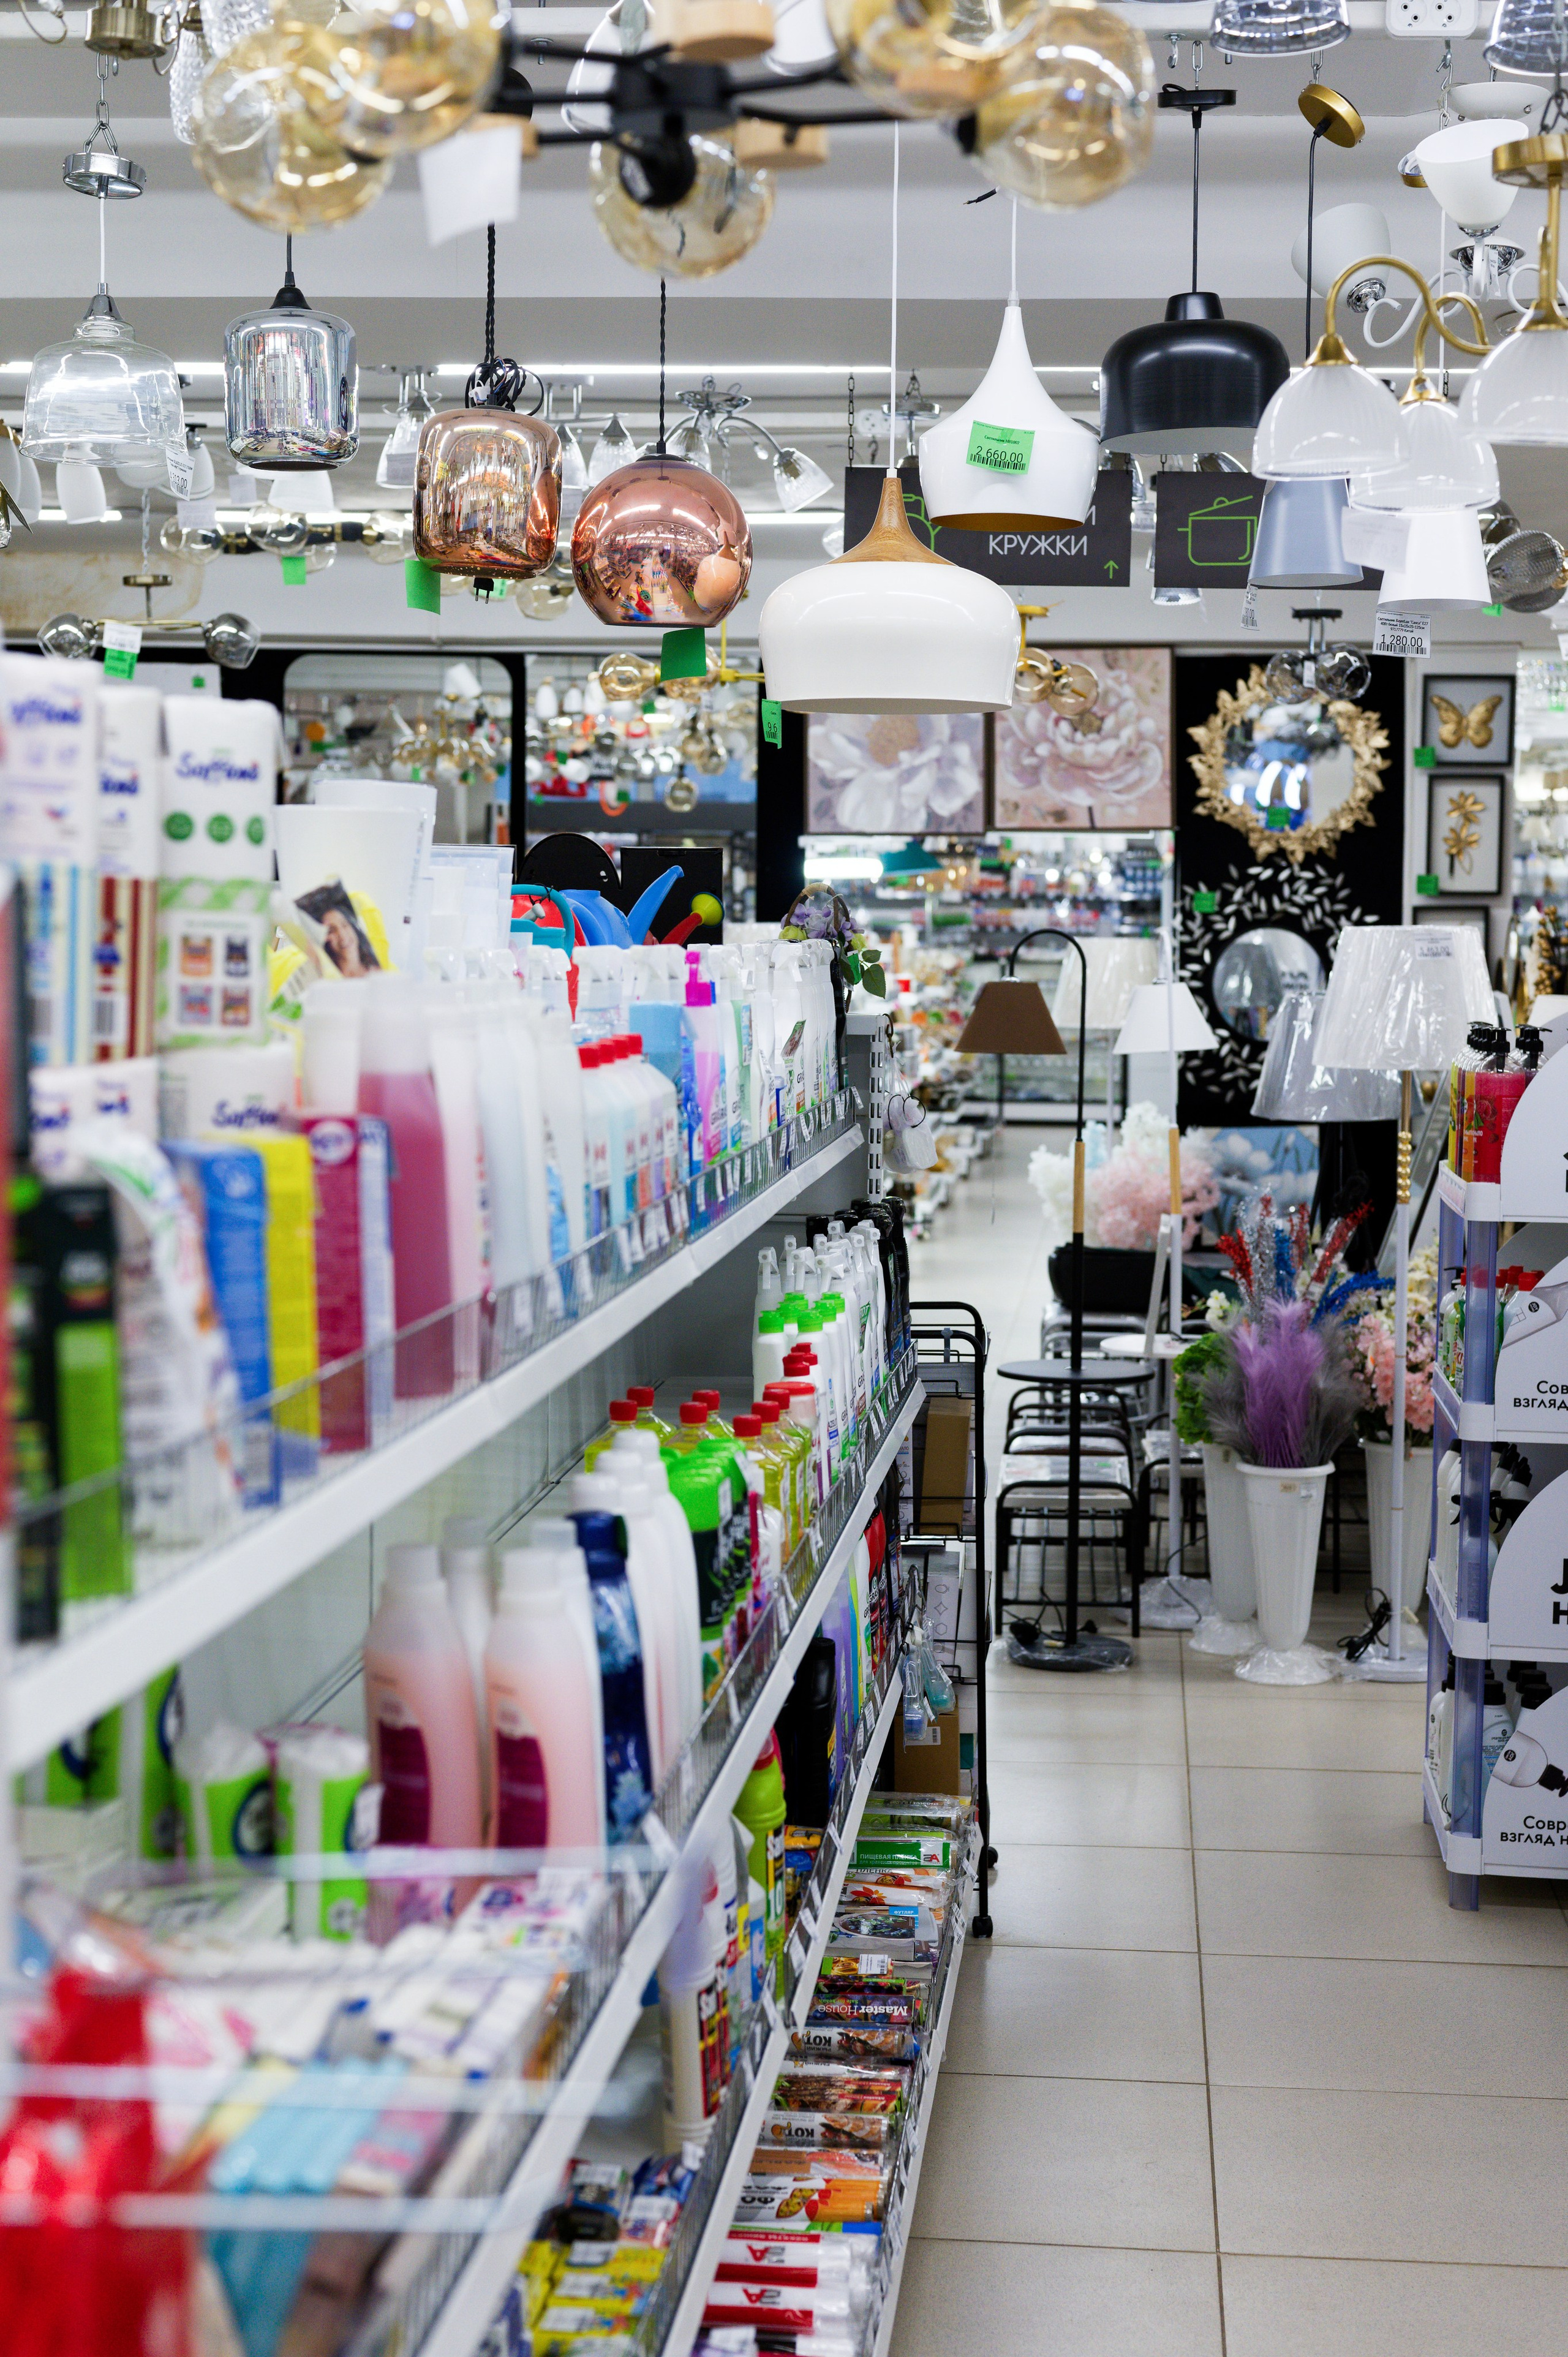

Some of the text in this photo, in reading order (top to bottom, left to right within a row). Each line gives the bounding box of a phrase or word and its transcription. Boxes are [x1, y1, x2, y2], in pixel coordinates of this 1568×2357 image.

[976, 445, 1023, 463] 2 660.00
[989, 534, 1087, 556] КРУЖКИ
[1381, 633, 1423, 647] 1 280.00
[805, 2035, 832, 2046] КОТ
[785, 2127, 815, 2138] КОТ
